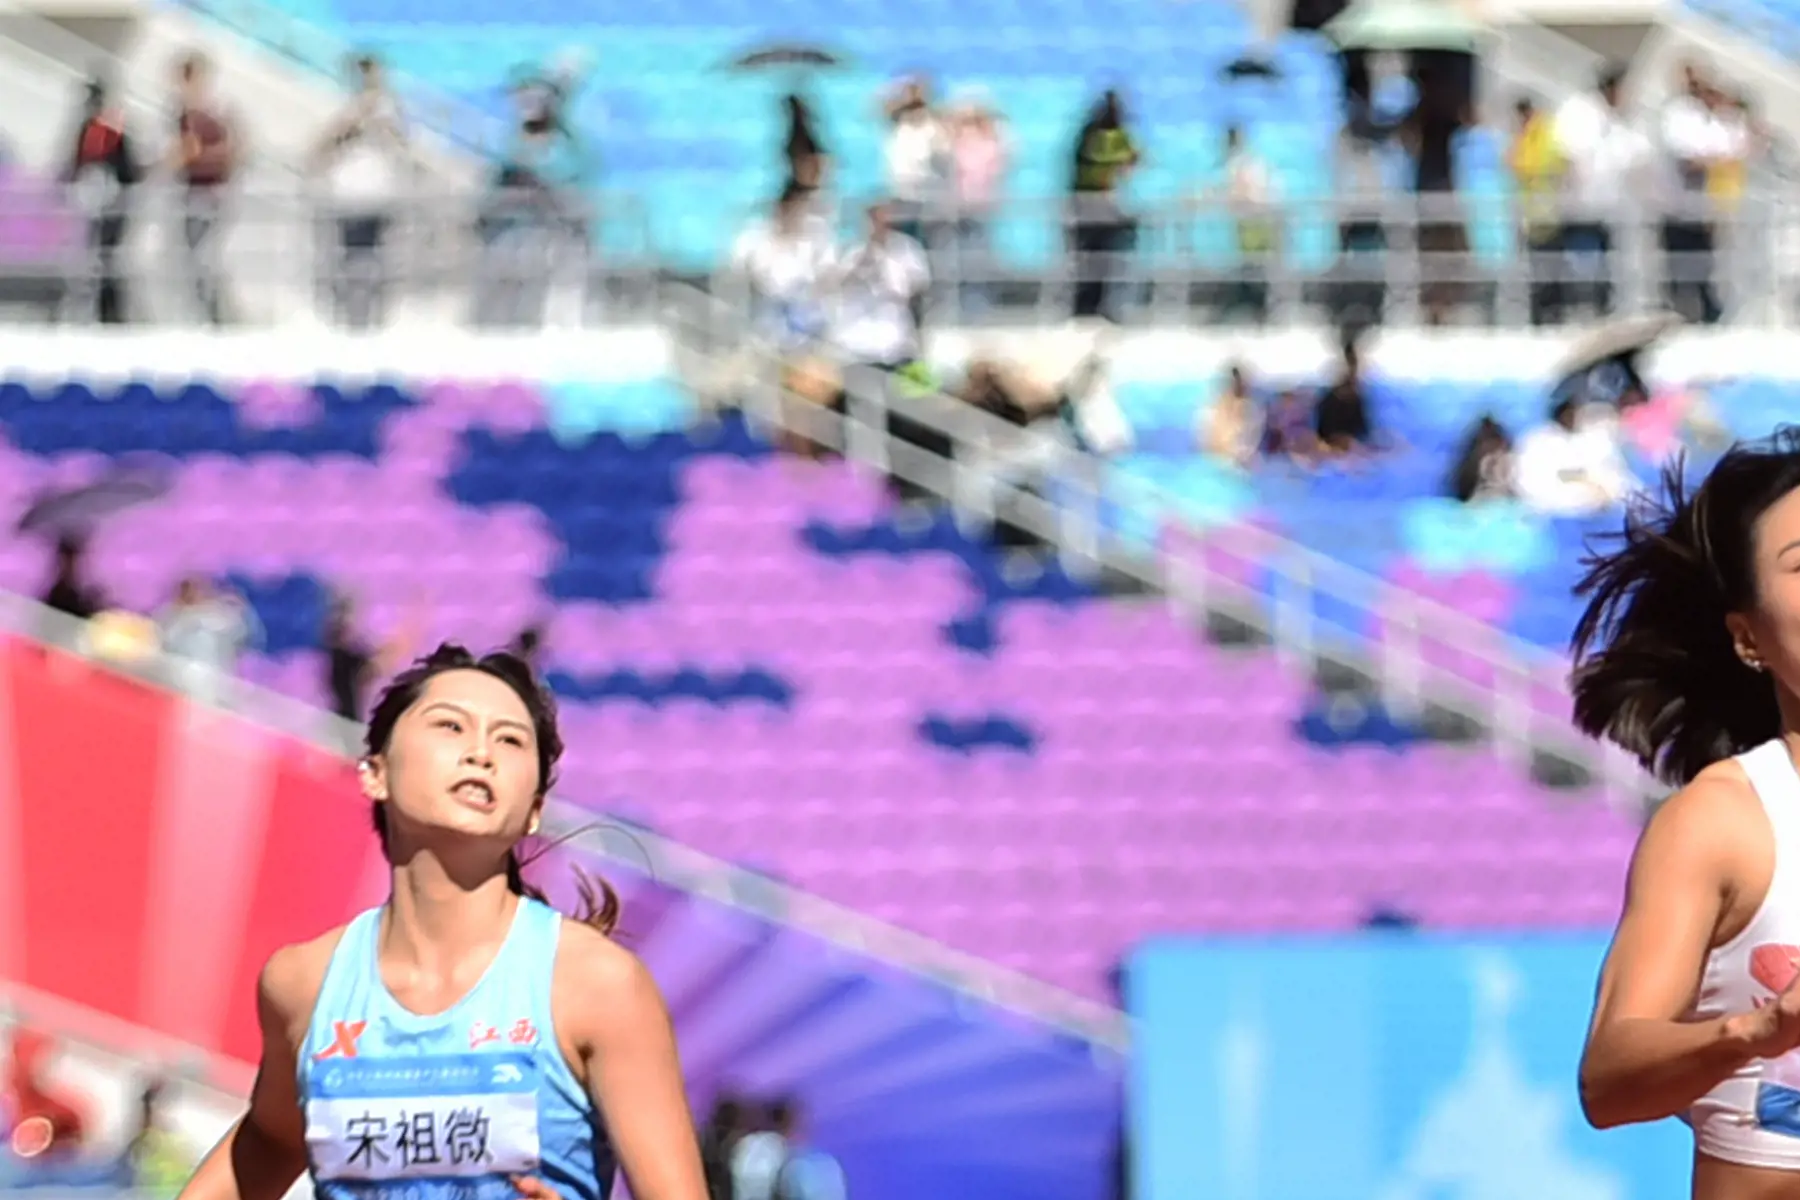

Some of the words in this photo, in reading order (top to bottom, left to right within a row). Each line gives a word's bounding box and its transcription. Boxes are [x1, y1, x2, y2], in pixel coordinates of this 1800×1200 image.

[470, 1018, 537, 1048] 江西
[345, 1107, 493, 1168] 宋祖微
